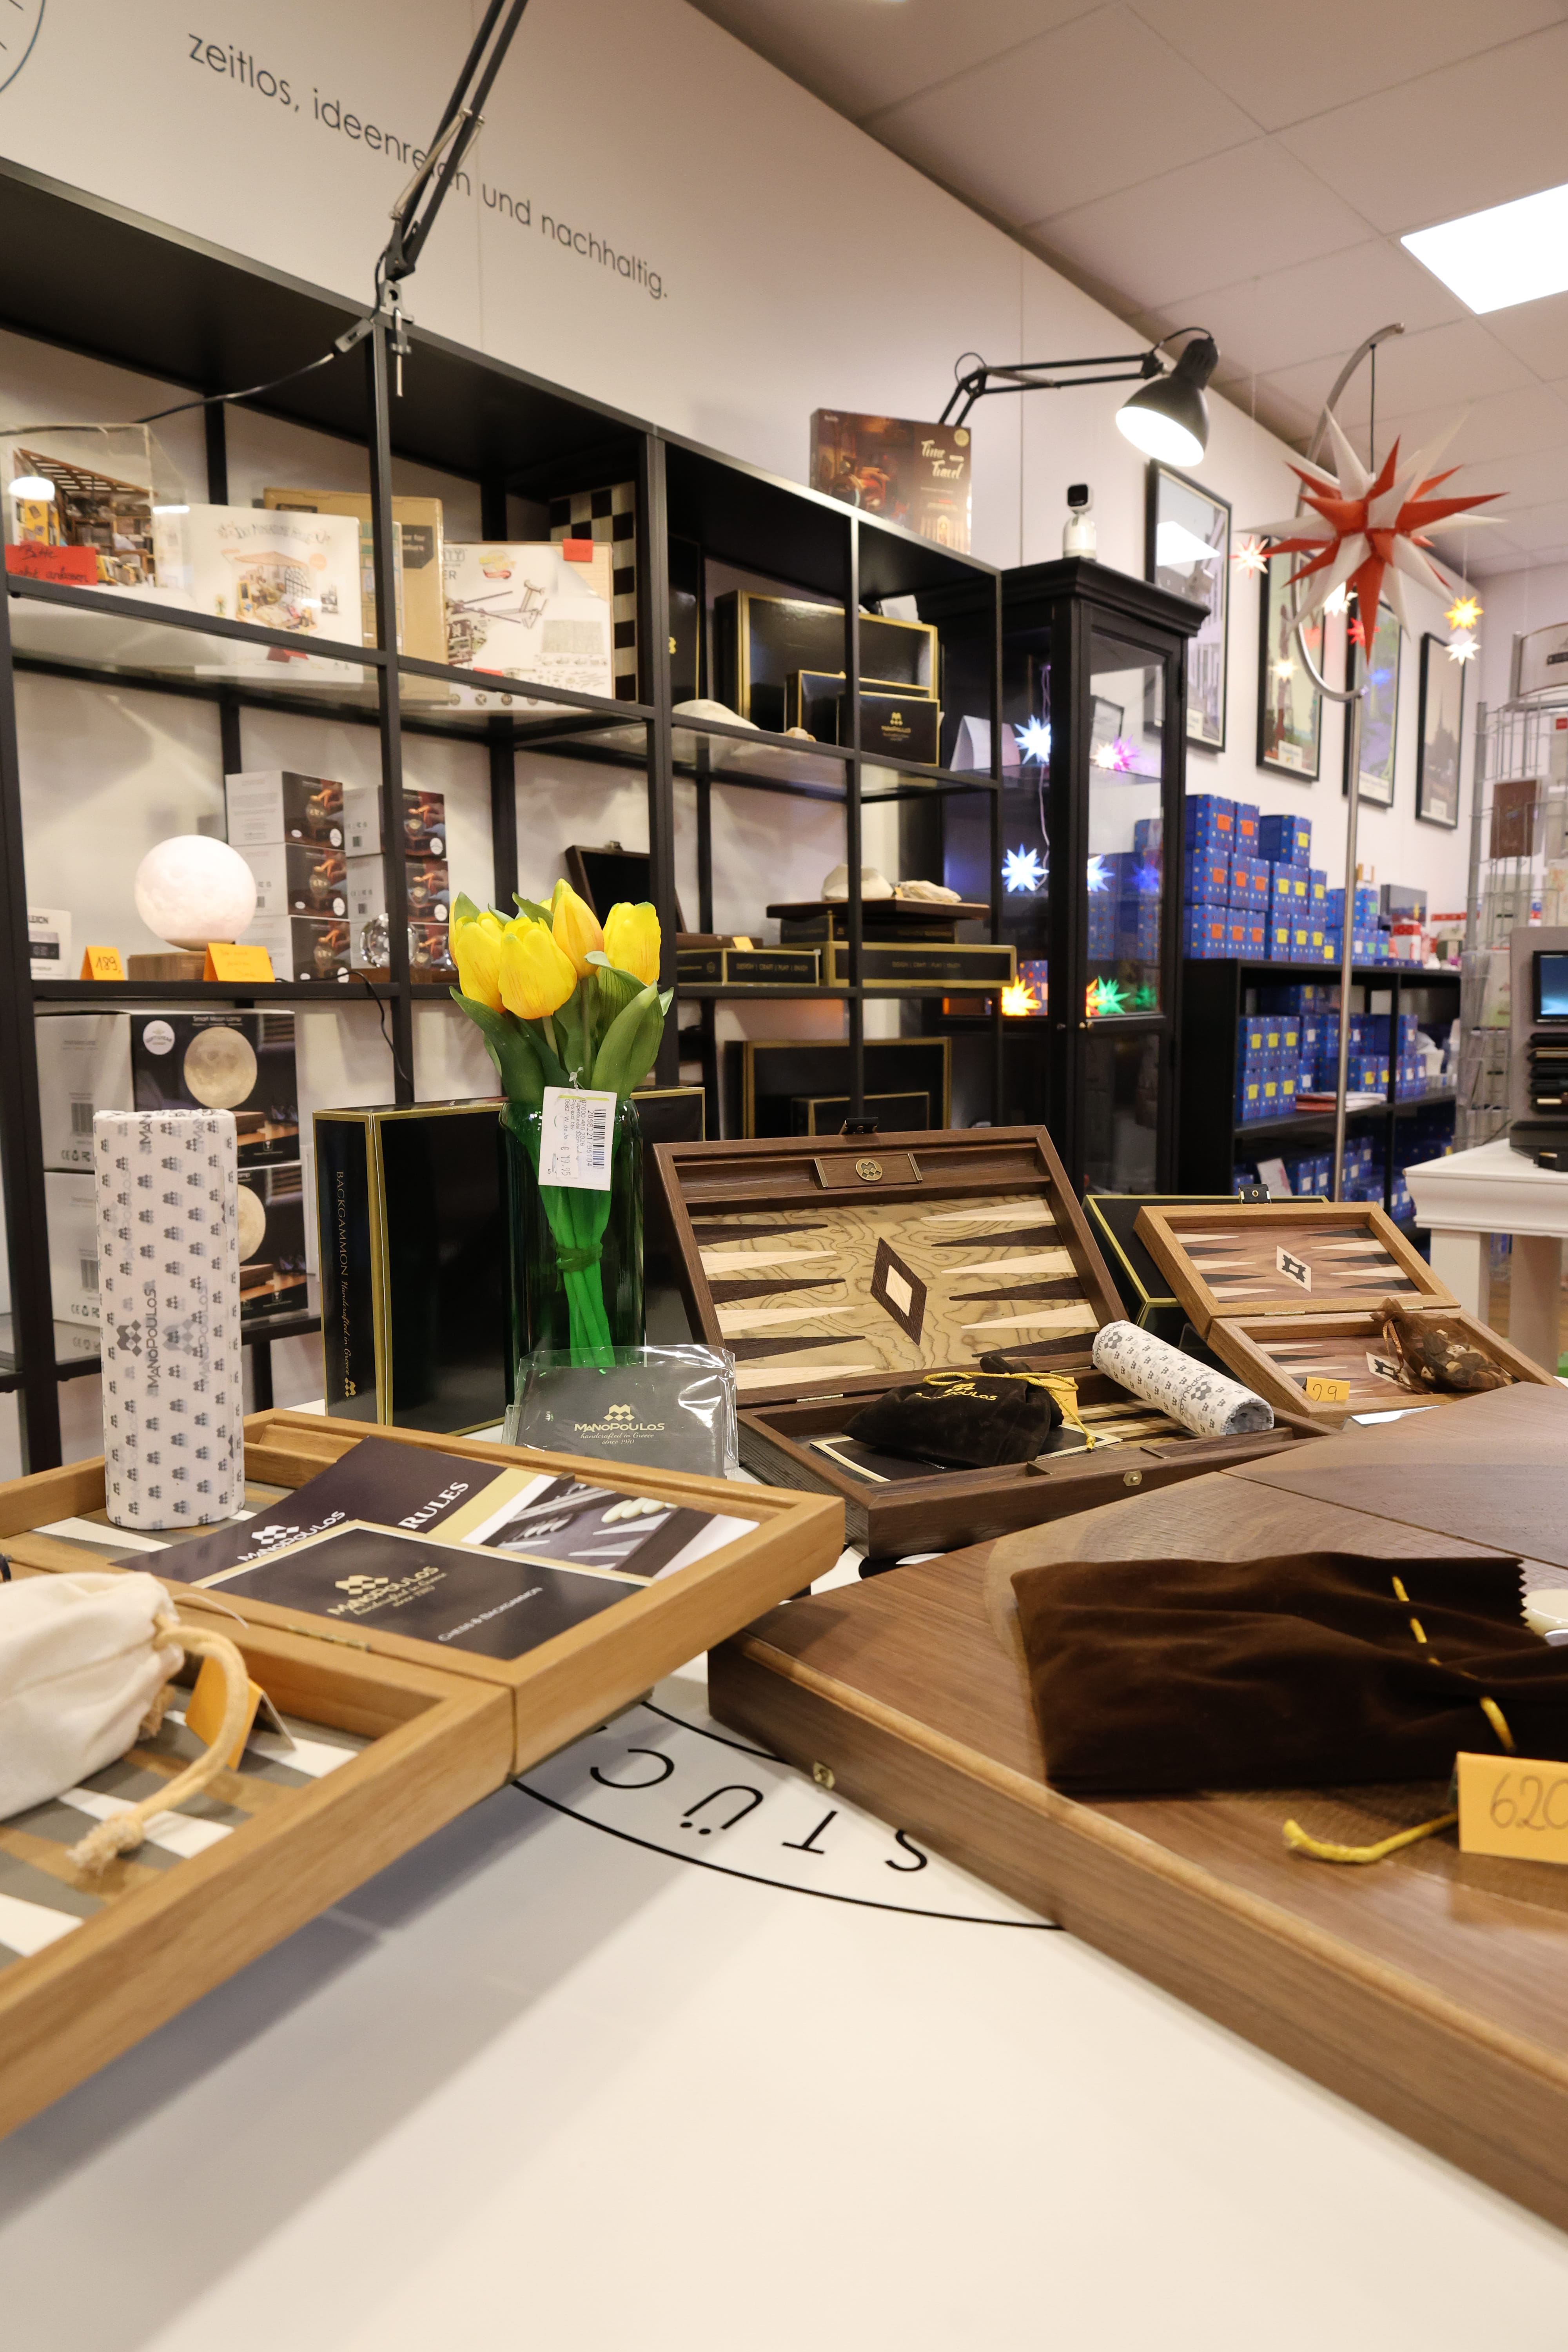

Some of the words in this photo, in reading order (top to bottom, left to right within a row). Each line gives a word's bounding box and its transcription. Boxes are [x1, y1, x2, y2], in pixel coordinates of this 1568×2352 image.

[188, 33, 299, 111] zeitlos,
[482, 183, 530, 225] und
[541, 213, 667, 299] nachhaltig.
[336, 1171, 348, 1276] BACKGAMMON
[341, 1280, 350, 1336] Handcrafted
[344, 1337, 350, 1345] in
[574, 1423, 665, 1432] MANOPOULOS
[398, 1481, 469, 1530] RULES
